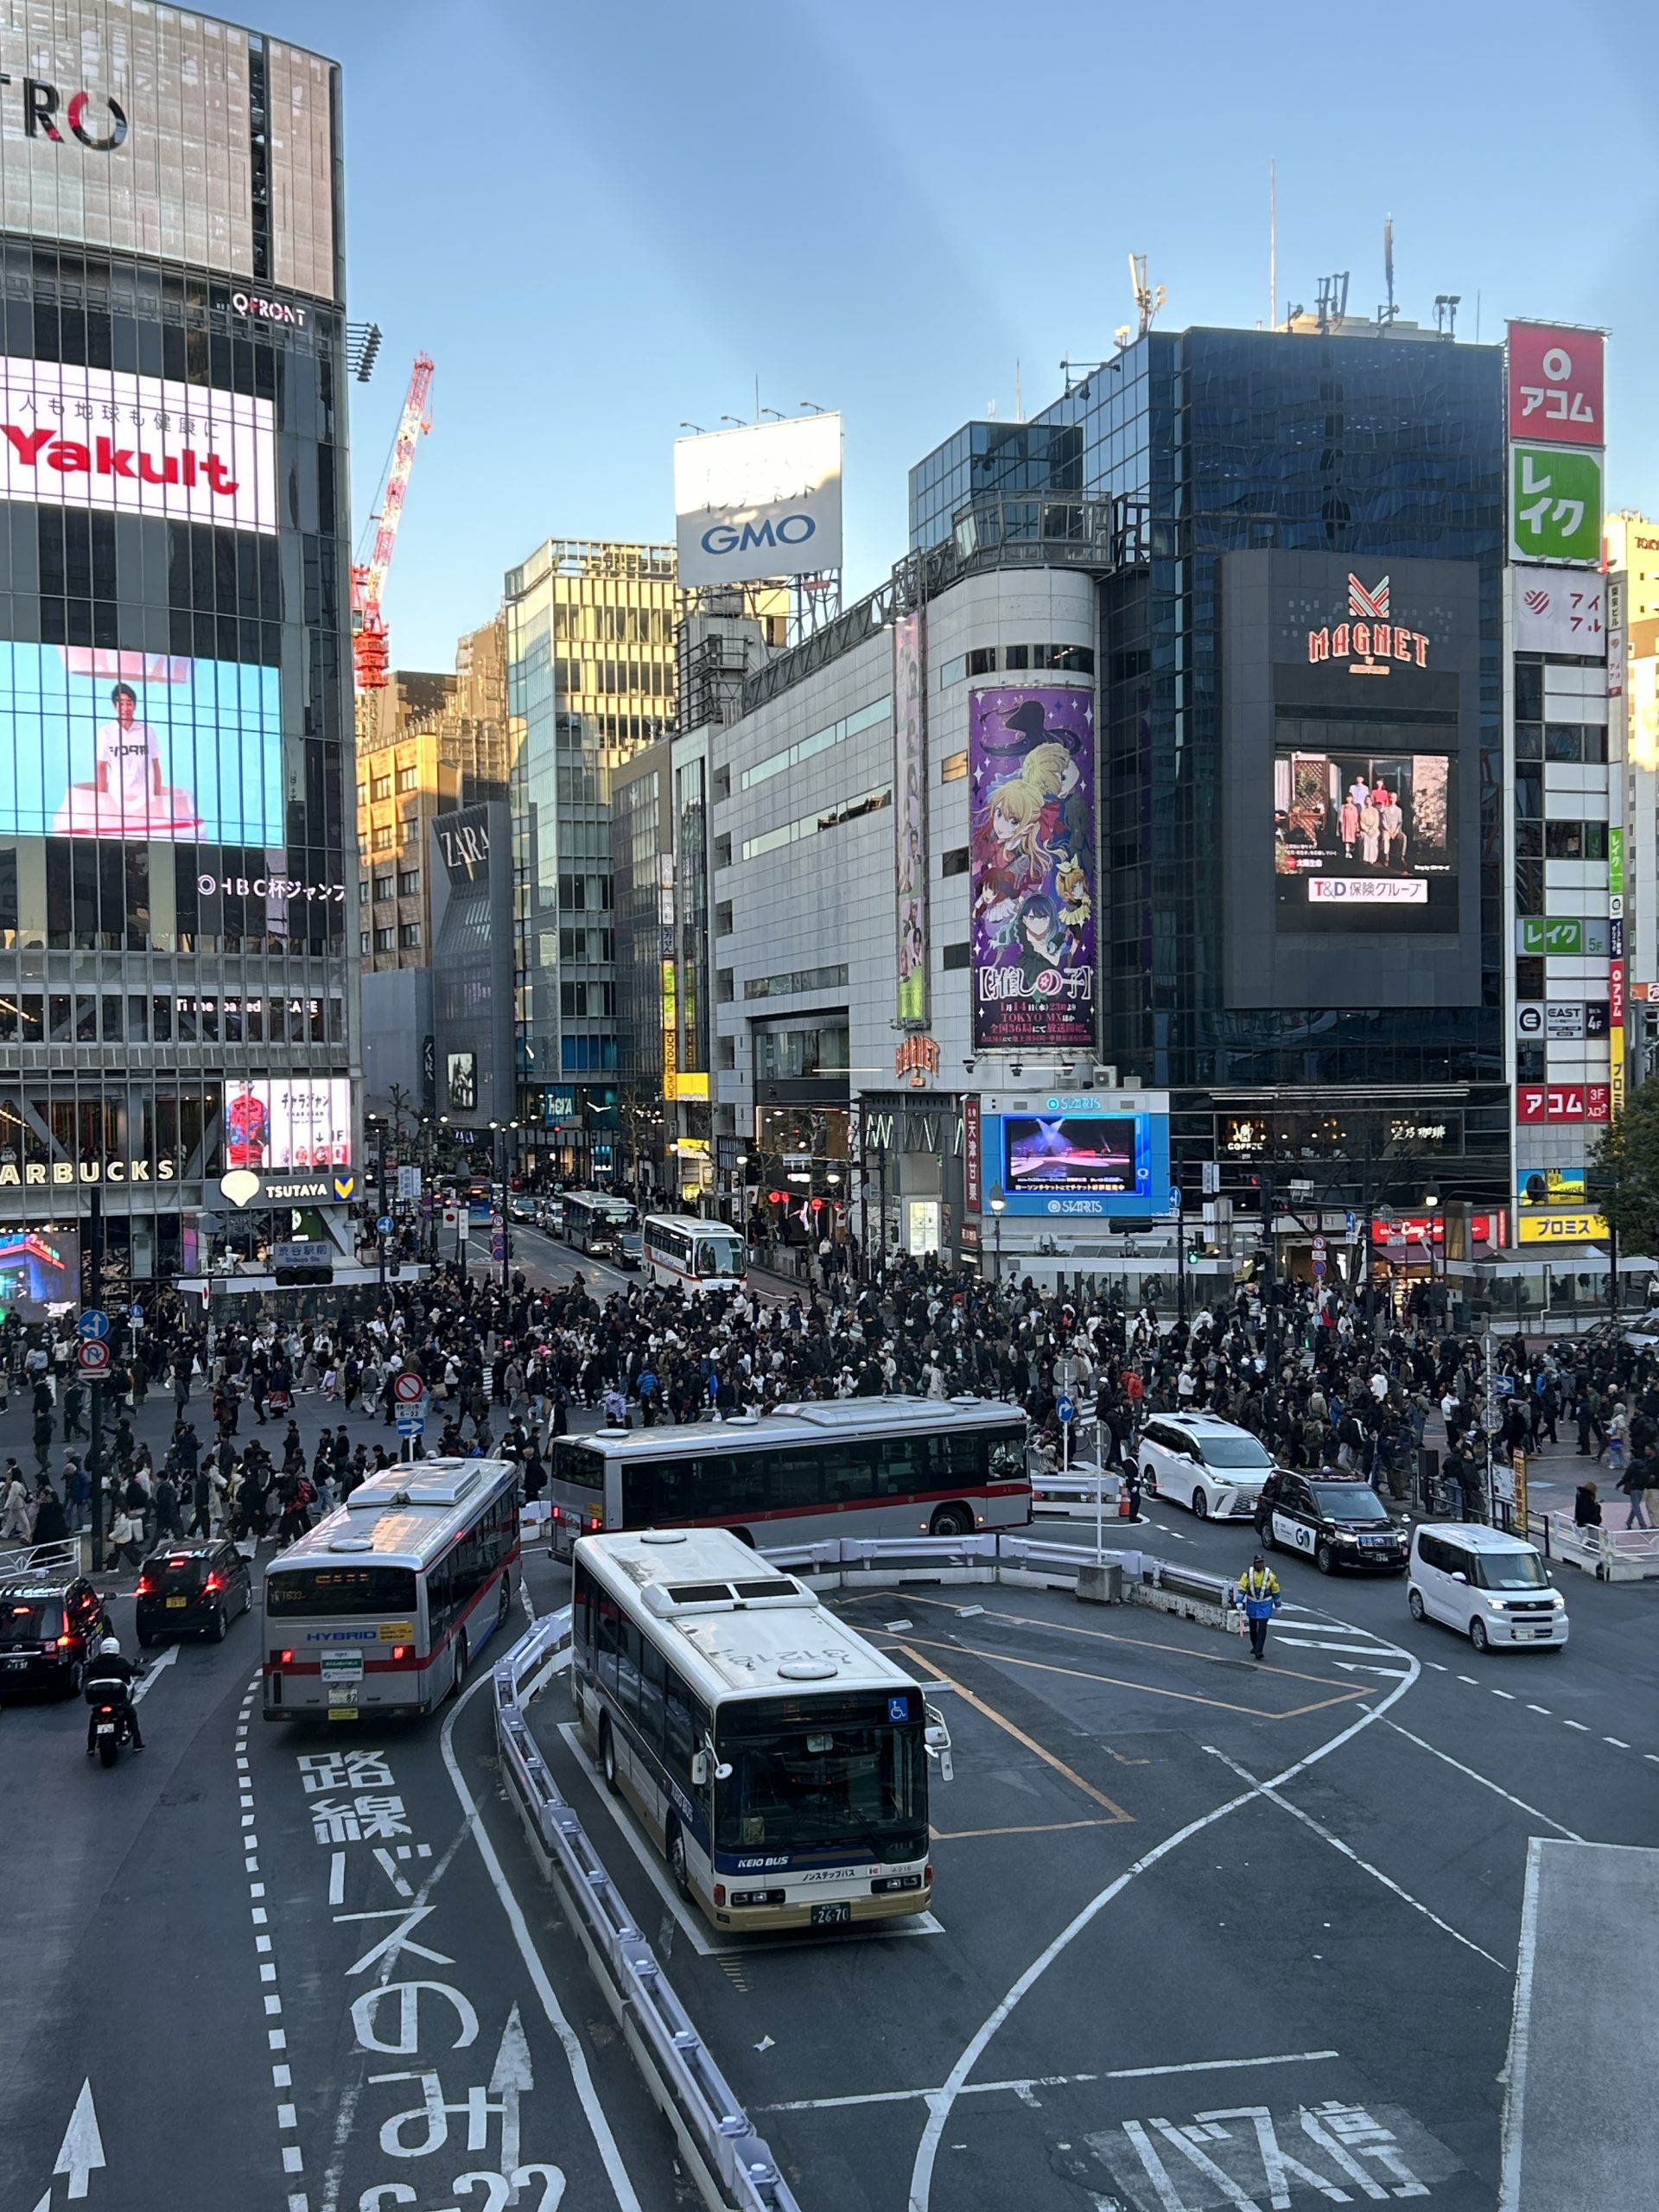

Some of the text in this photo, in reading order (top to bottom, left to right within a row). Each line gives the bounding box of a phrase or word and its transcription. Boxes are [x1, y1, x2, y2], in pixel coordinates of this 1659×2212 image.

[0, 73, 128, 151] RO
[232, 292, 306, 327] QFRONT
[1520, 385, 1594, 423] アコム
[19, 394, 220, 440] 人も地球も健康に
[0, 424, 240, 495] Yakult
[701, 514, 817, 556] GMO
[1308, 622, 1430, 669] MAGNET
[440, 825, 490, 867] ZARA
[1611, 836, 1620, 868] レイク
[1313, 880, 1422, 899] T&D 保険グループ
[1527, 925, 1603, 951] レイク 5F
[1548, 1007, 1582, 1018] EAST
[1612, 983, 1622, 1017] アコム
[1001, 1013, 1042, 1022] TOKYO
[1587, 1014, 1603, 1030] 4F
[664, 1031, 676, 1065] TOUCH
[664, 1065, 674, 1100] MOM'S
[1590, 1089, 1605, 1101] 3F
[1612, 1062, 1623, 1111] プロミ
[1526, 1093, 1583, 1114] アコム
[0, 1160, 174, 1185] ARBUCKS
[265, 1183, 327, 1198] TSUTAYA
[1062, 1200, 1103, 1213] STARTS
[1537, 1219, 1591, 1236] プロミス
[278, 1244, 327, 1256] 渋谷駅前
[307, 1630, 377, 1642] HYBRID
[737, 1856, 789, 1869] KEIO BUS
[802, 1869, 855, 1882] ノンステップバス
